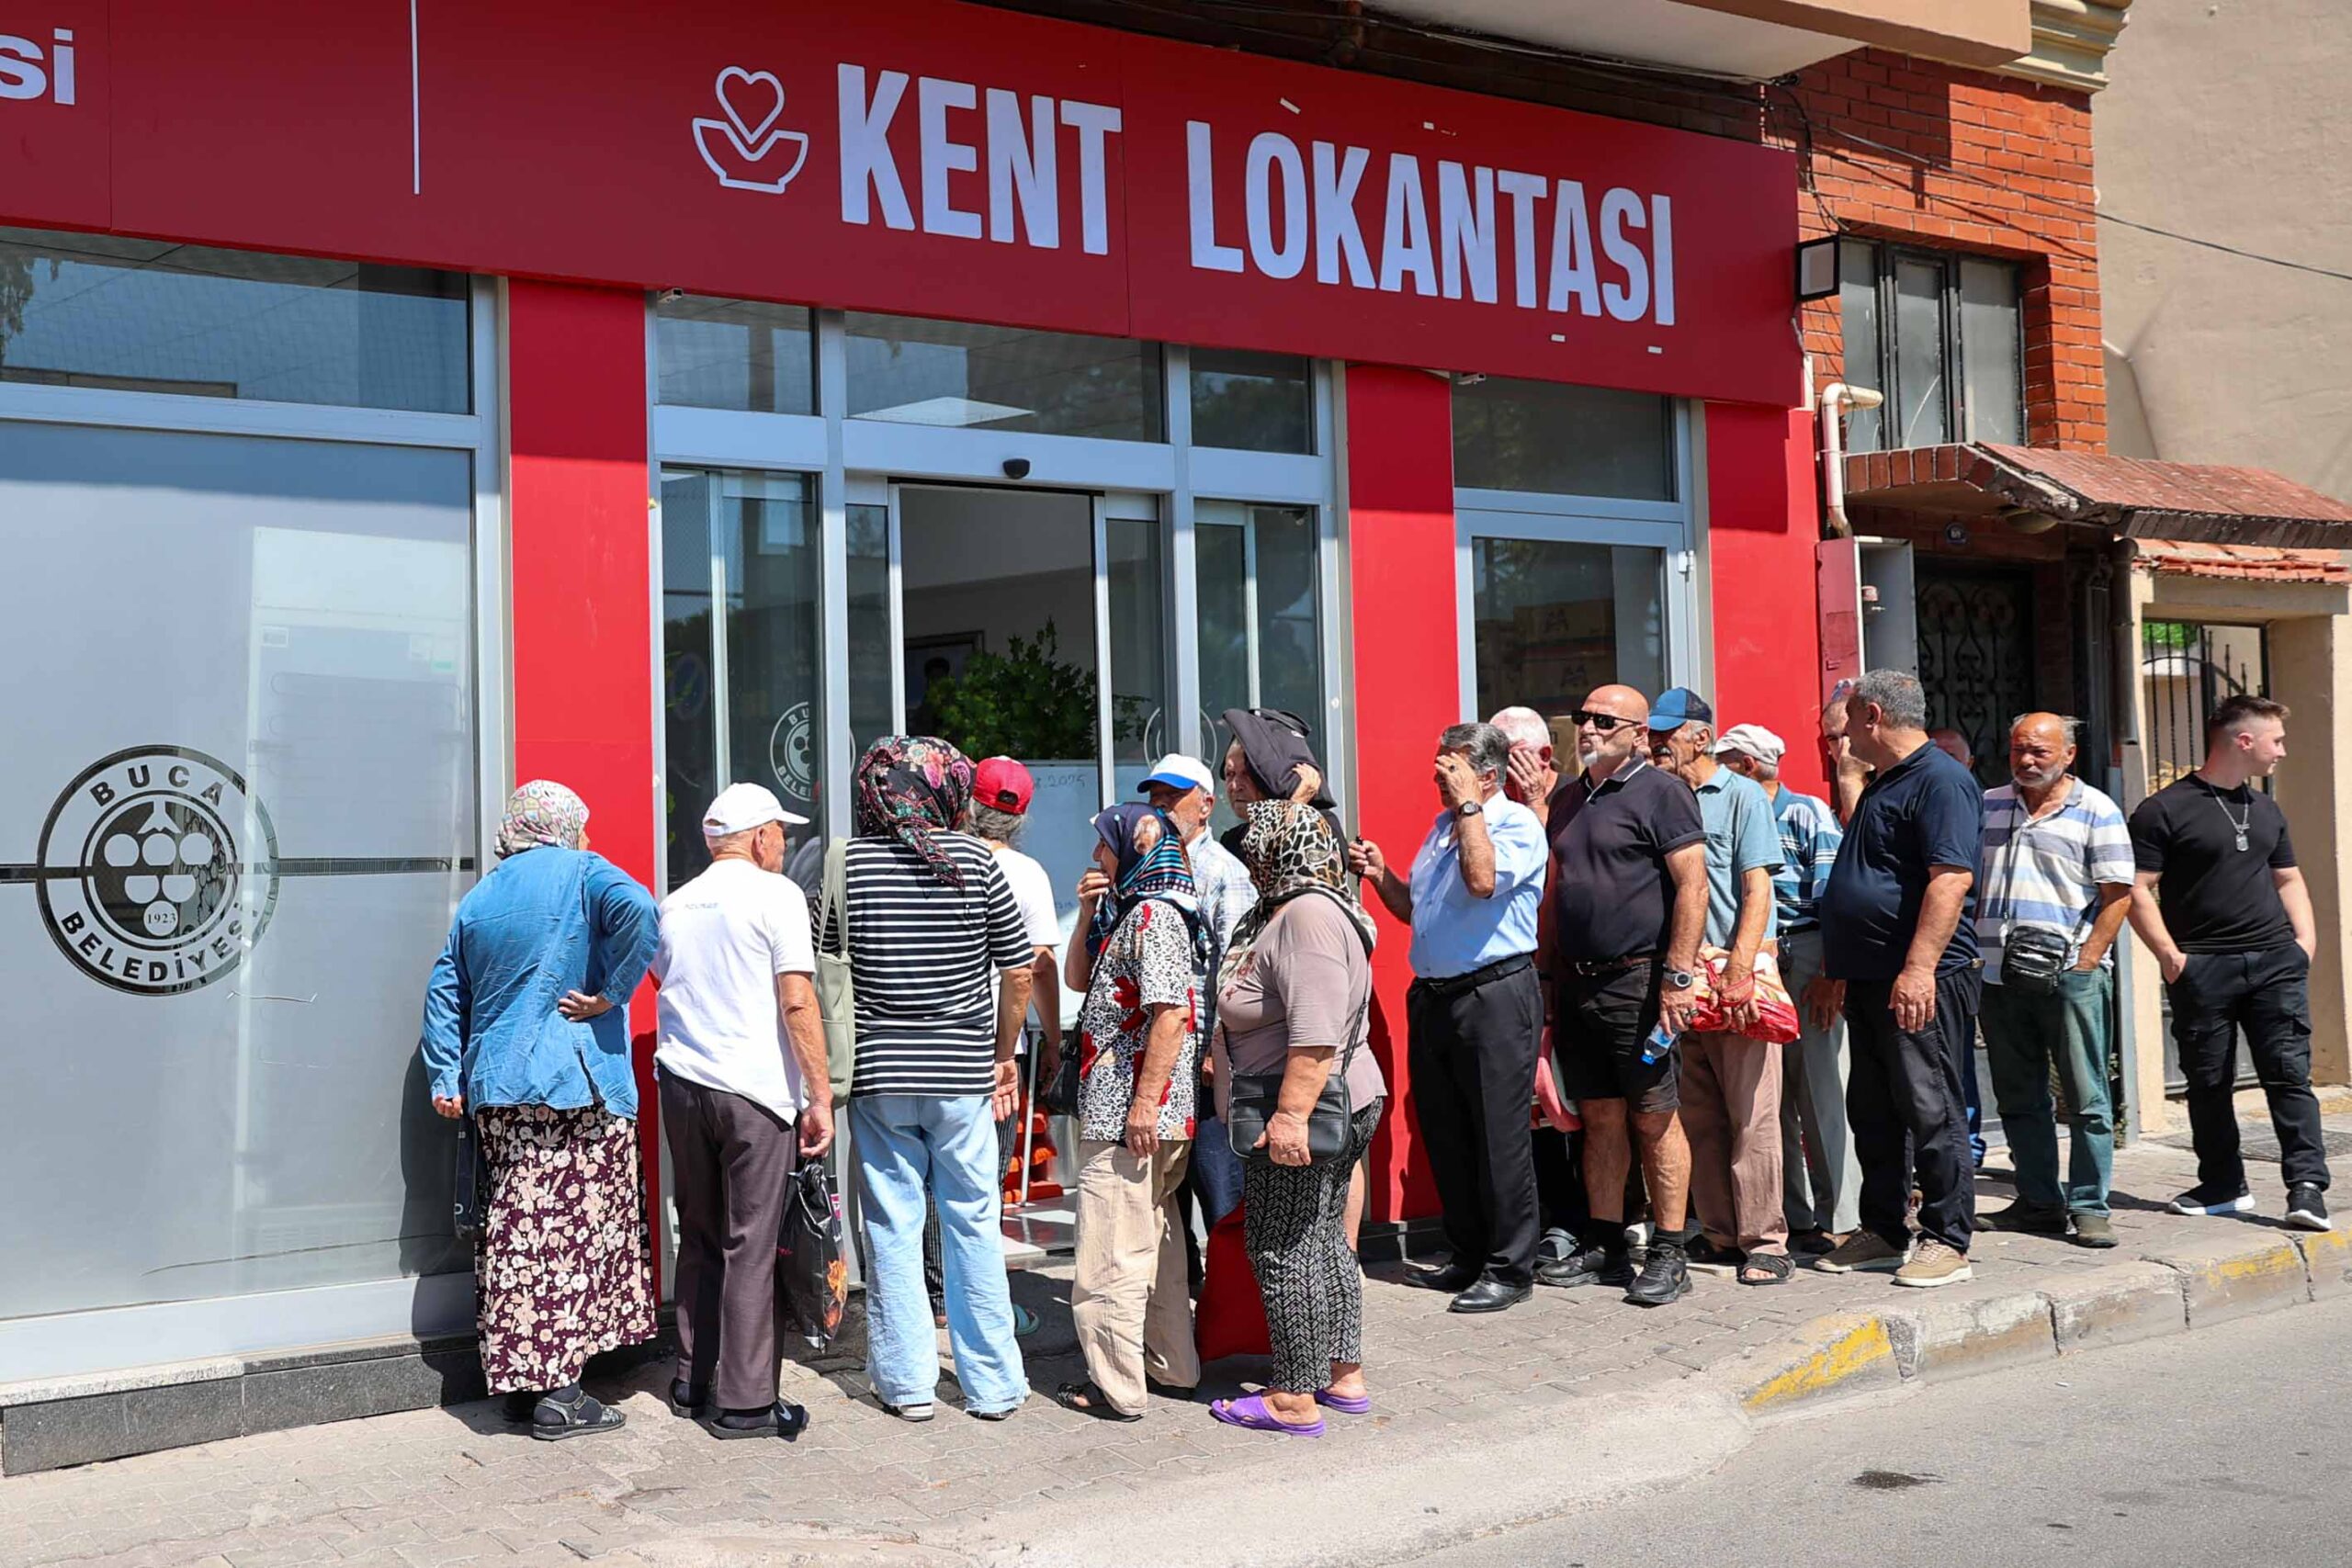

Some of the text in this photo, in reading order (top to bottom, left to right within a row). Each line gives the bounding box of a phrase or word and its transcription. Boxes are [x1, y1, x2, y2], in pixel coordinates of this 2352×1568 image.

[838, 62, 1675, 326] KENT LOKANTASI
[89, 764, 223, 807] BUCA
[148, 912, 176, 924] 1923
